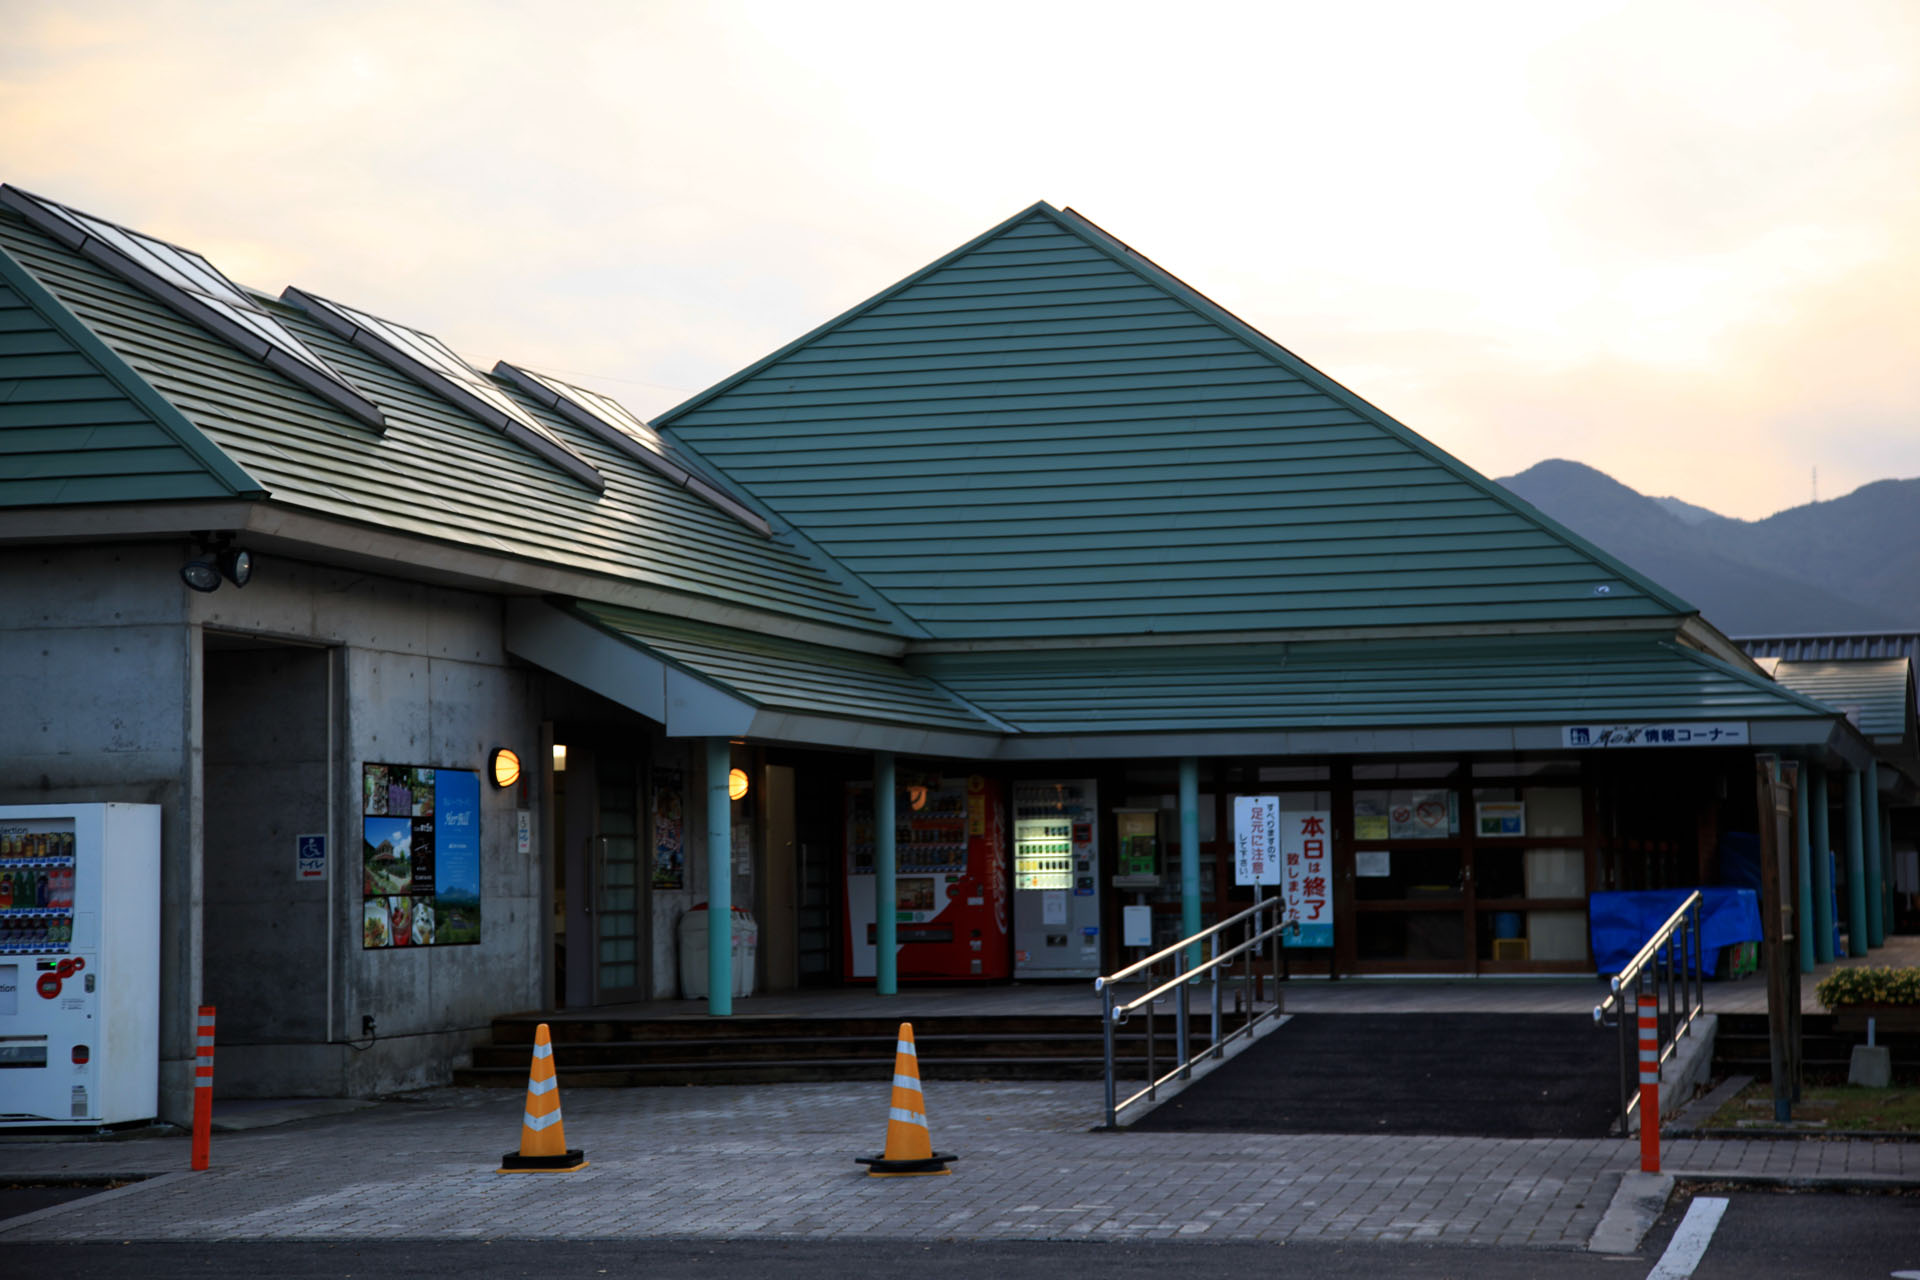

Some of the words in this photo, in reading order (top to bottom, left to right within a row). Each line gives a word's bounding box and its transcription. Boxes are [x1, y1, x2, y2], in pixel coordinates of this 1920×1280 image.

[1645, 727, 1740, 743] 情報コーナー
[1250, 807, 1264, 874] 足元に注意
[1266, 803, 1277, 863] すべりますので
[1287, 852, 1301, 920] 致しました
[1301, 816, 1327, 920] 本日は終了
